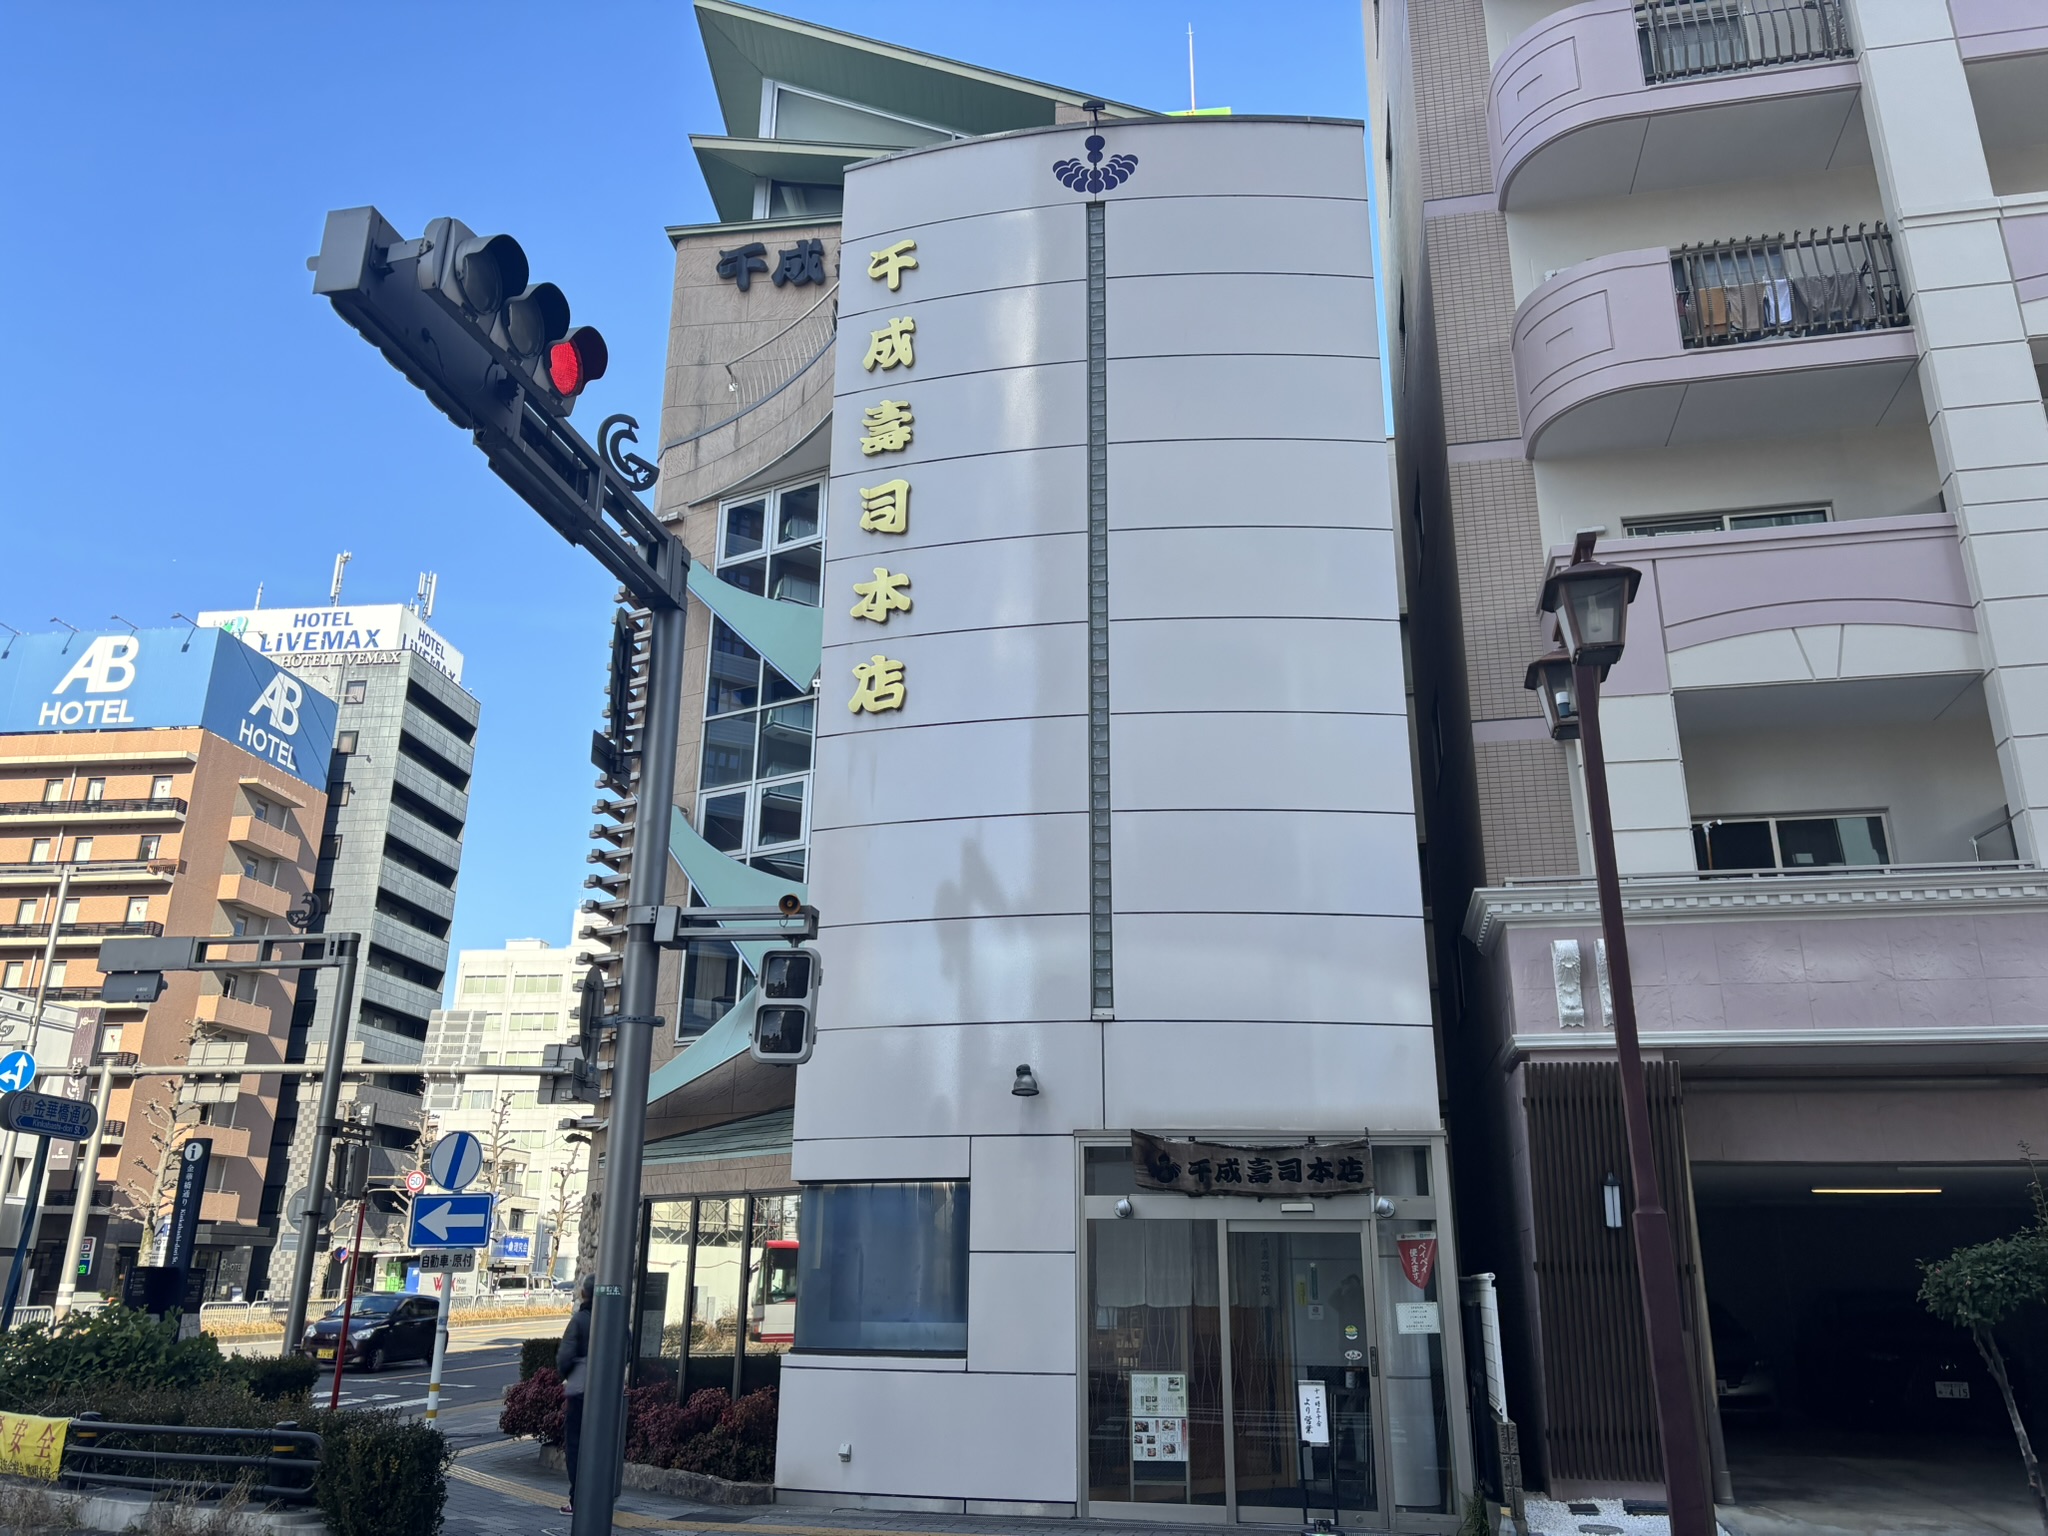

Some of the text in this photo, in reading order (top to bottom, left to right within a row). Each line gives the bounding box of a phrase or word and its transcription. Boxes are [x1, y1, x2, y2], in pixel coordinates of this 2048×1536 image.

[716, 238, 840, 292] 千成
[848, 239, 918, 714] 千成壽司本店
[293, 612, 353, 628] HOTEL
[418, 627, 445, 660] HOTEL
[52, 635, 139, 695] AB
[281, 655, 328, 668] HOTEL
[38, 699, 134, 726] HOTEL
[249, 671, 302, 736] AB
[239, 718, 297, 771] HOTEL
[33, 1100, 92, 1125] 金華橋通り
[182, 1164, 195, 1206] 金華橋通り
[409, 1175, 422, 1187] 50
[1188, 1157, 1364, 1184] 千成壽司本店
[421, 1254, 473, 1268] 自動車・原付
[1418, 1242, 1428, 1273] ペイペイ
